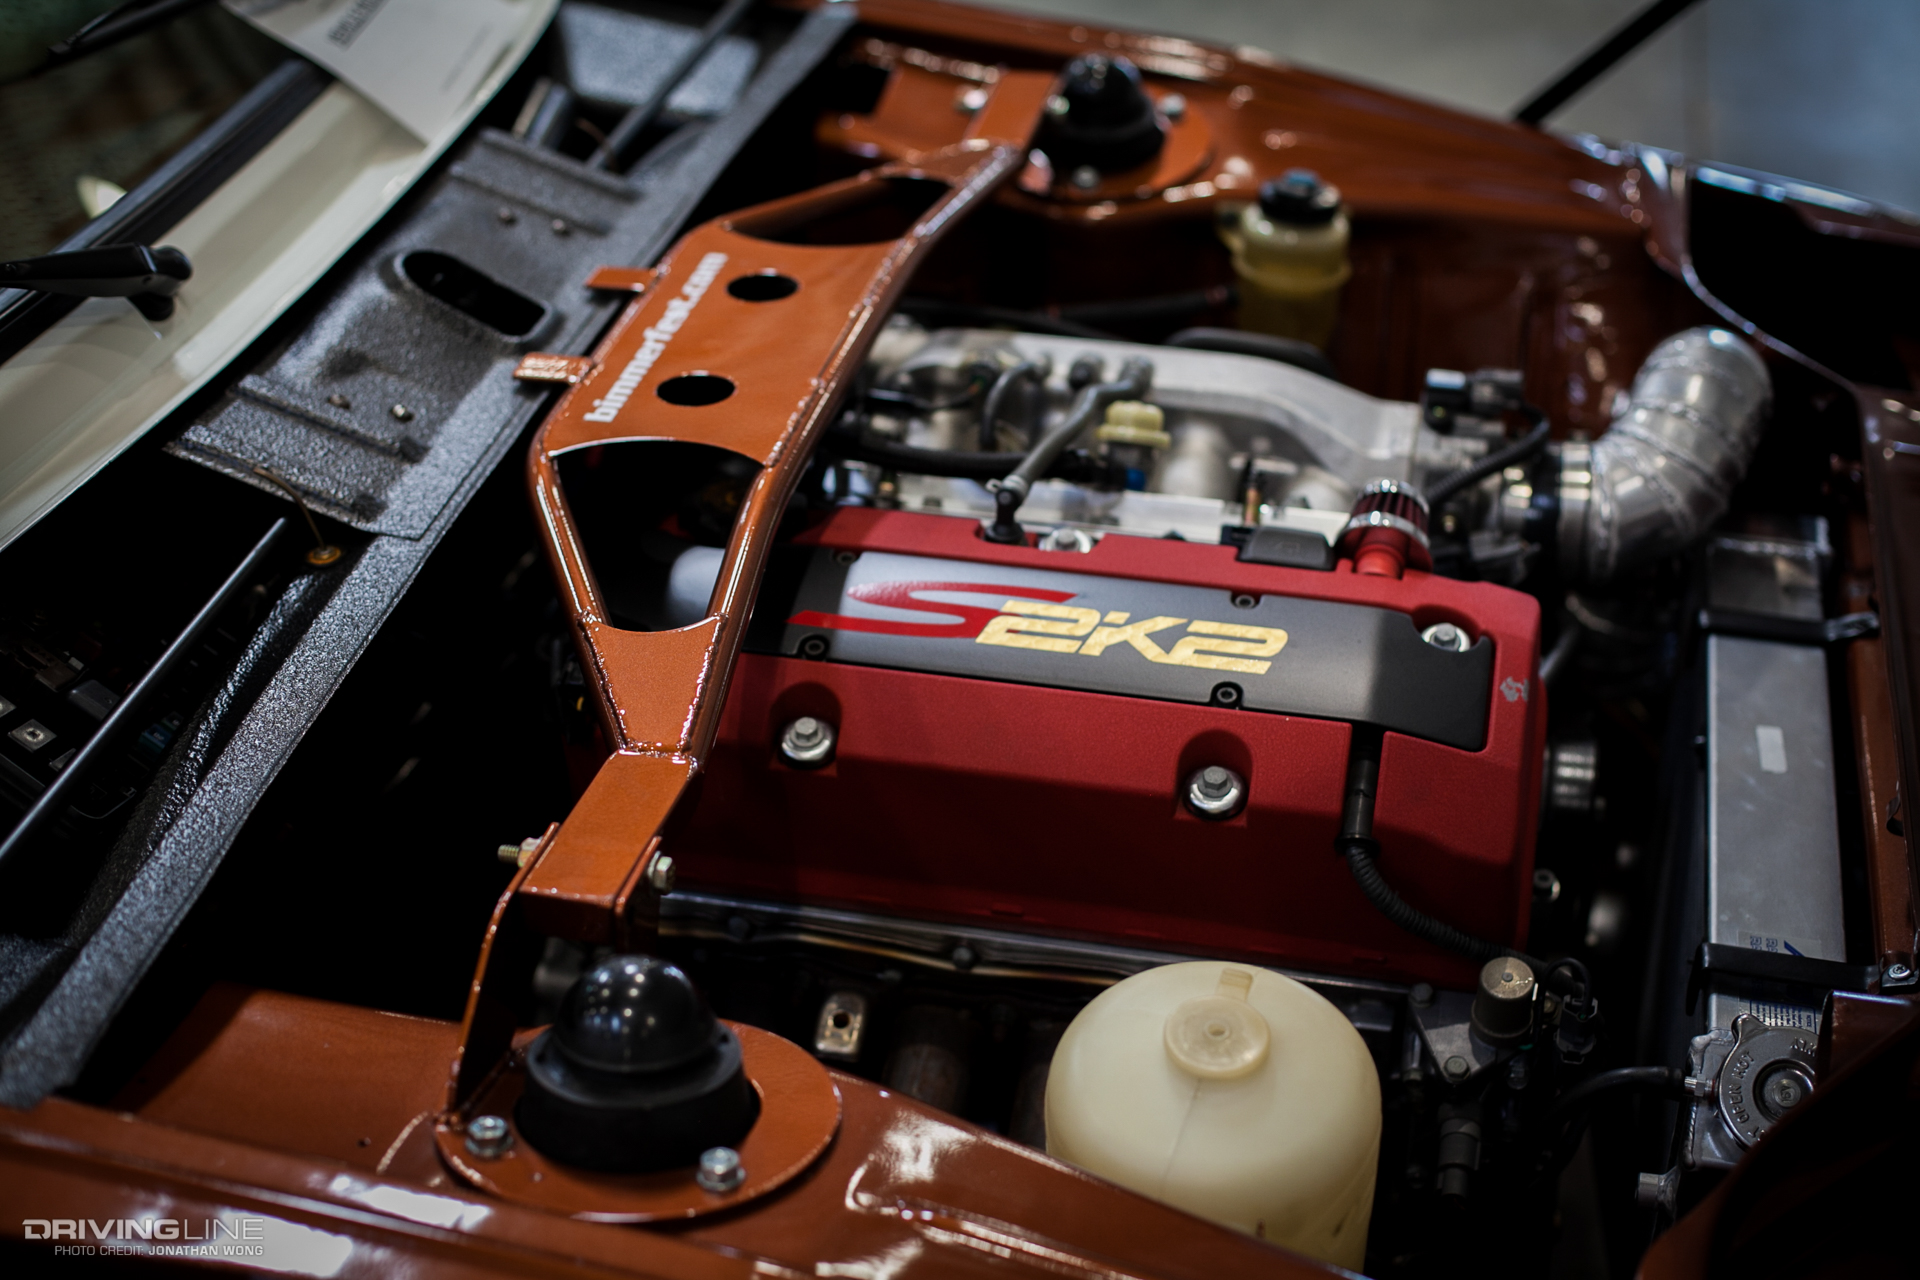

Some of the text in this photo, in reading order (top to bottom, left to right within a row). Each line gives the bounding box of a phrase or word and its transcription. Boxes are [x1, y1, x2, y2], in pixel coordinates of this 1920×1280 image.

[583, 252, 728, 422] bimmerfest.com
[1728, 1050, 1755, 1124] OPEN HOT
